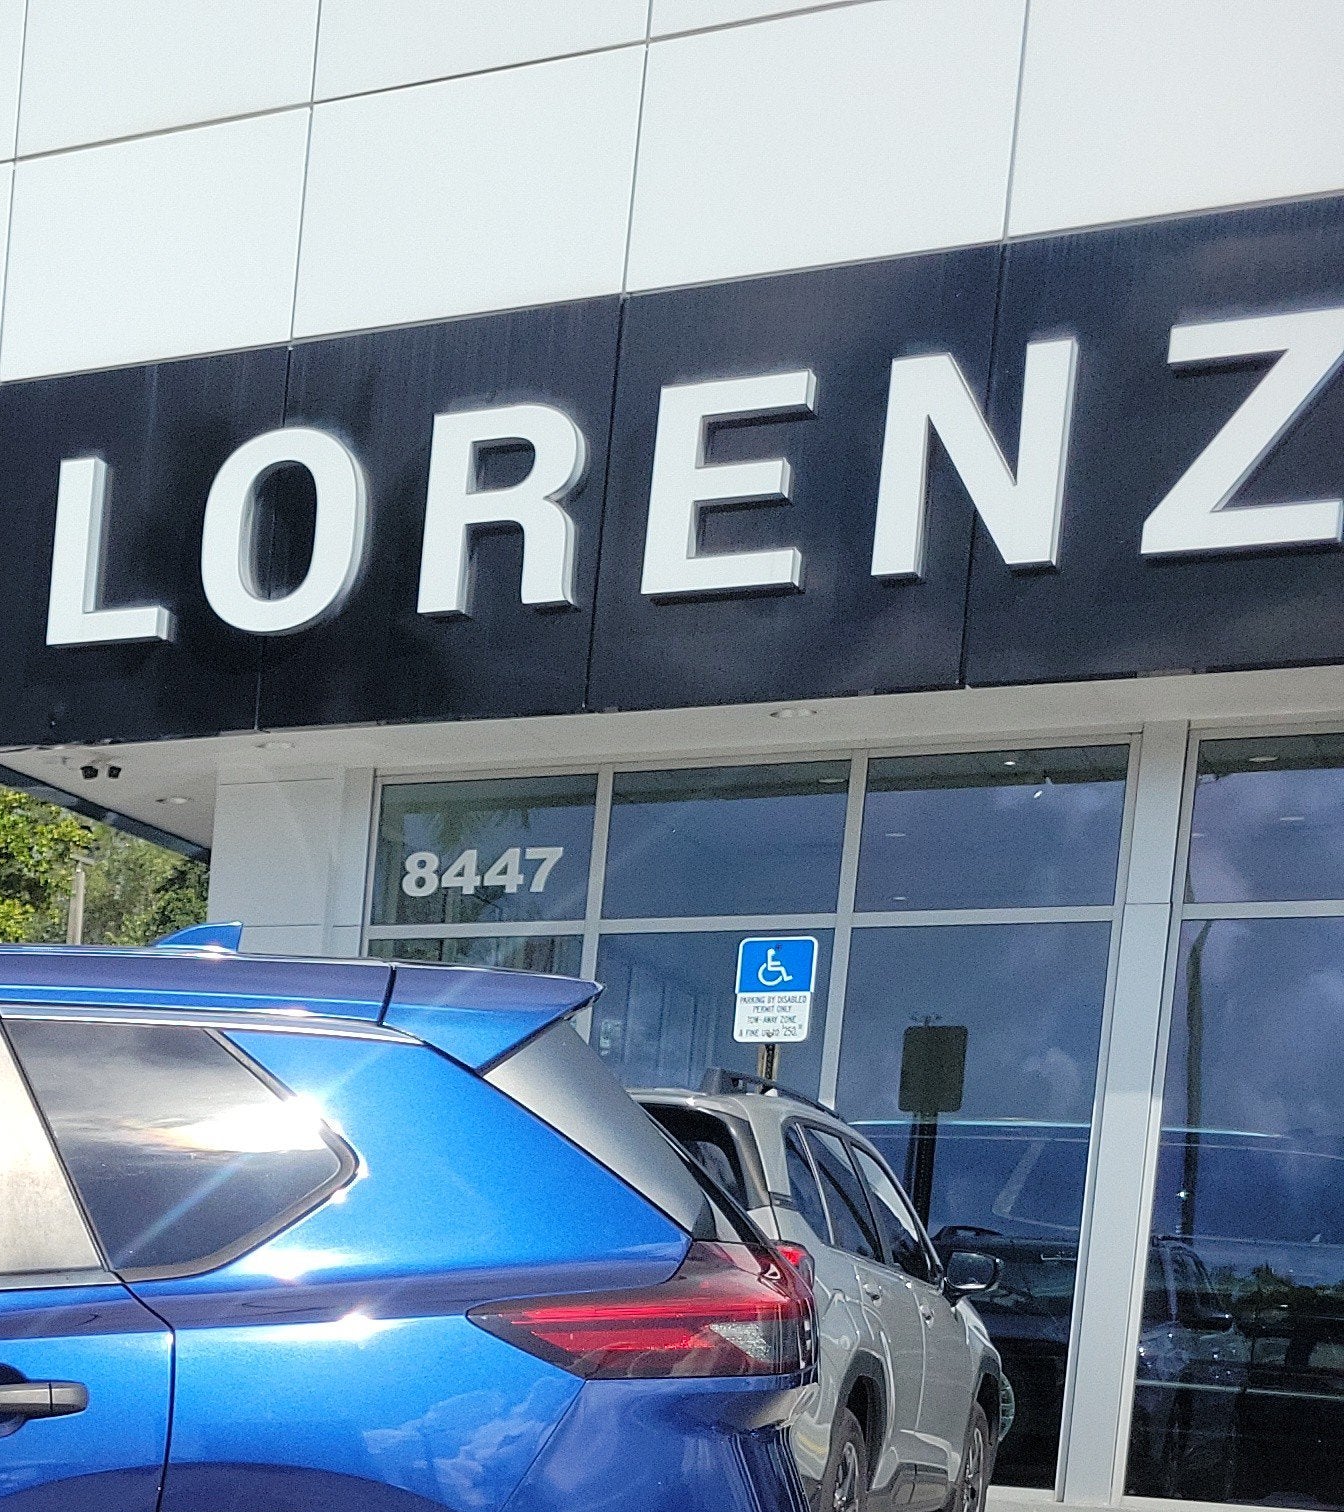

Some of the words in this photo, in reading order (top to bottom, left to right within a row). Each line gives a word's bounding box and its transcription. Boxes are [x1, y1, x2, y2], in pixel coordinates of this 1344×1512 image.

[46, 307, 1344, 646] LORENZ
[401, 847, 564, 897] 8447
[739, 996, 765, 1004] PARKING
[767, 995, 775, 1003] BY
[777, 995, 807, 1004] DISABLED
